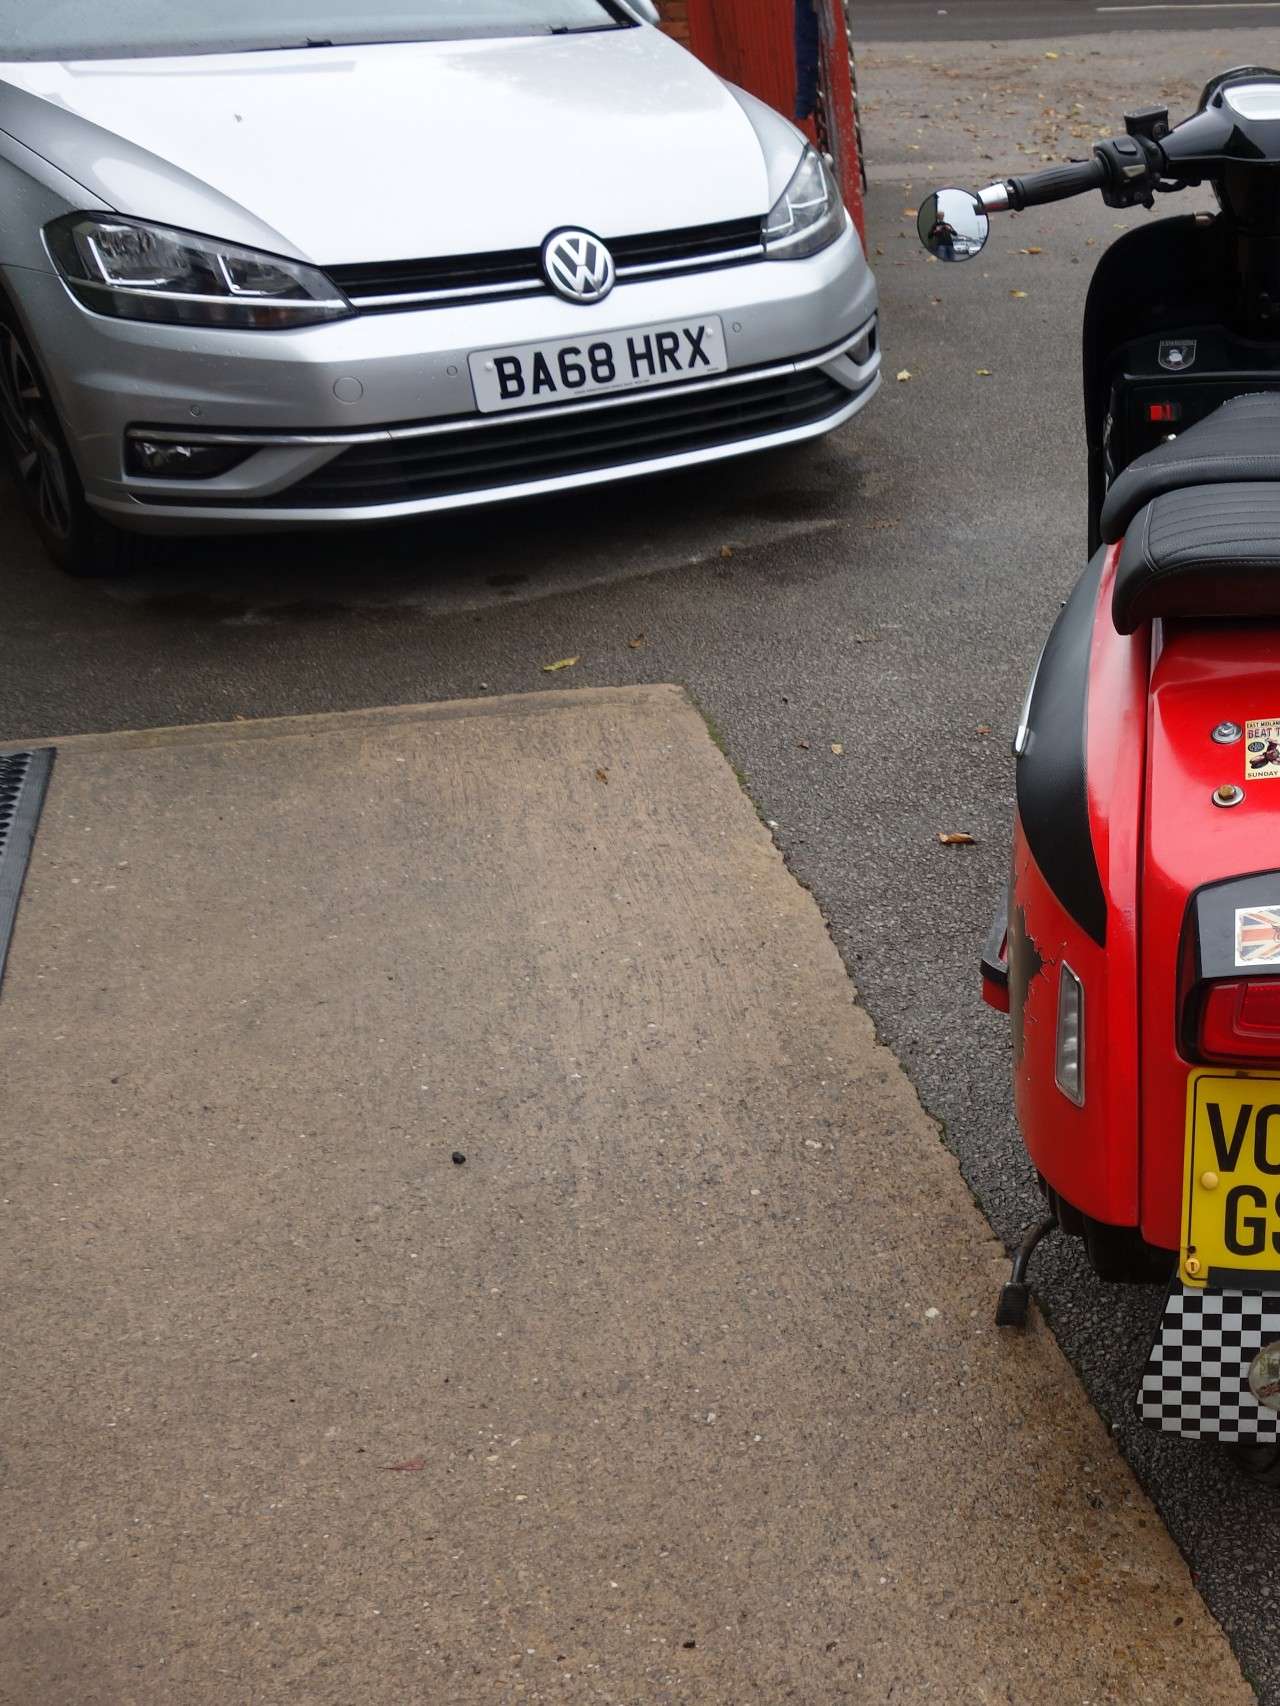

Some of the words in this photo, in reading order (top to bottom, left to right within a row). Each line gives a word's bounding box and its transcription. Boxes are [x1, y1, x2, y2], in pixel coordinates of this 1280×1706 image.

[493, 341, 616, 400] BA68
[626, 325, 711, 379] HRX
[1248, 727, 1273, 739] BEAT
